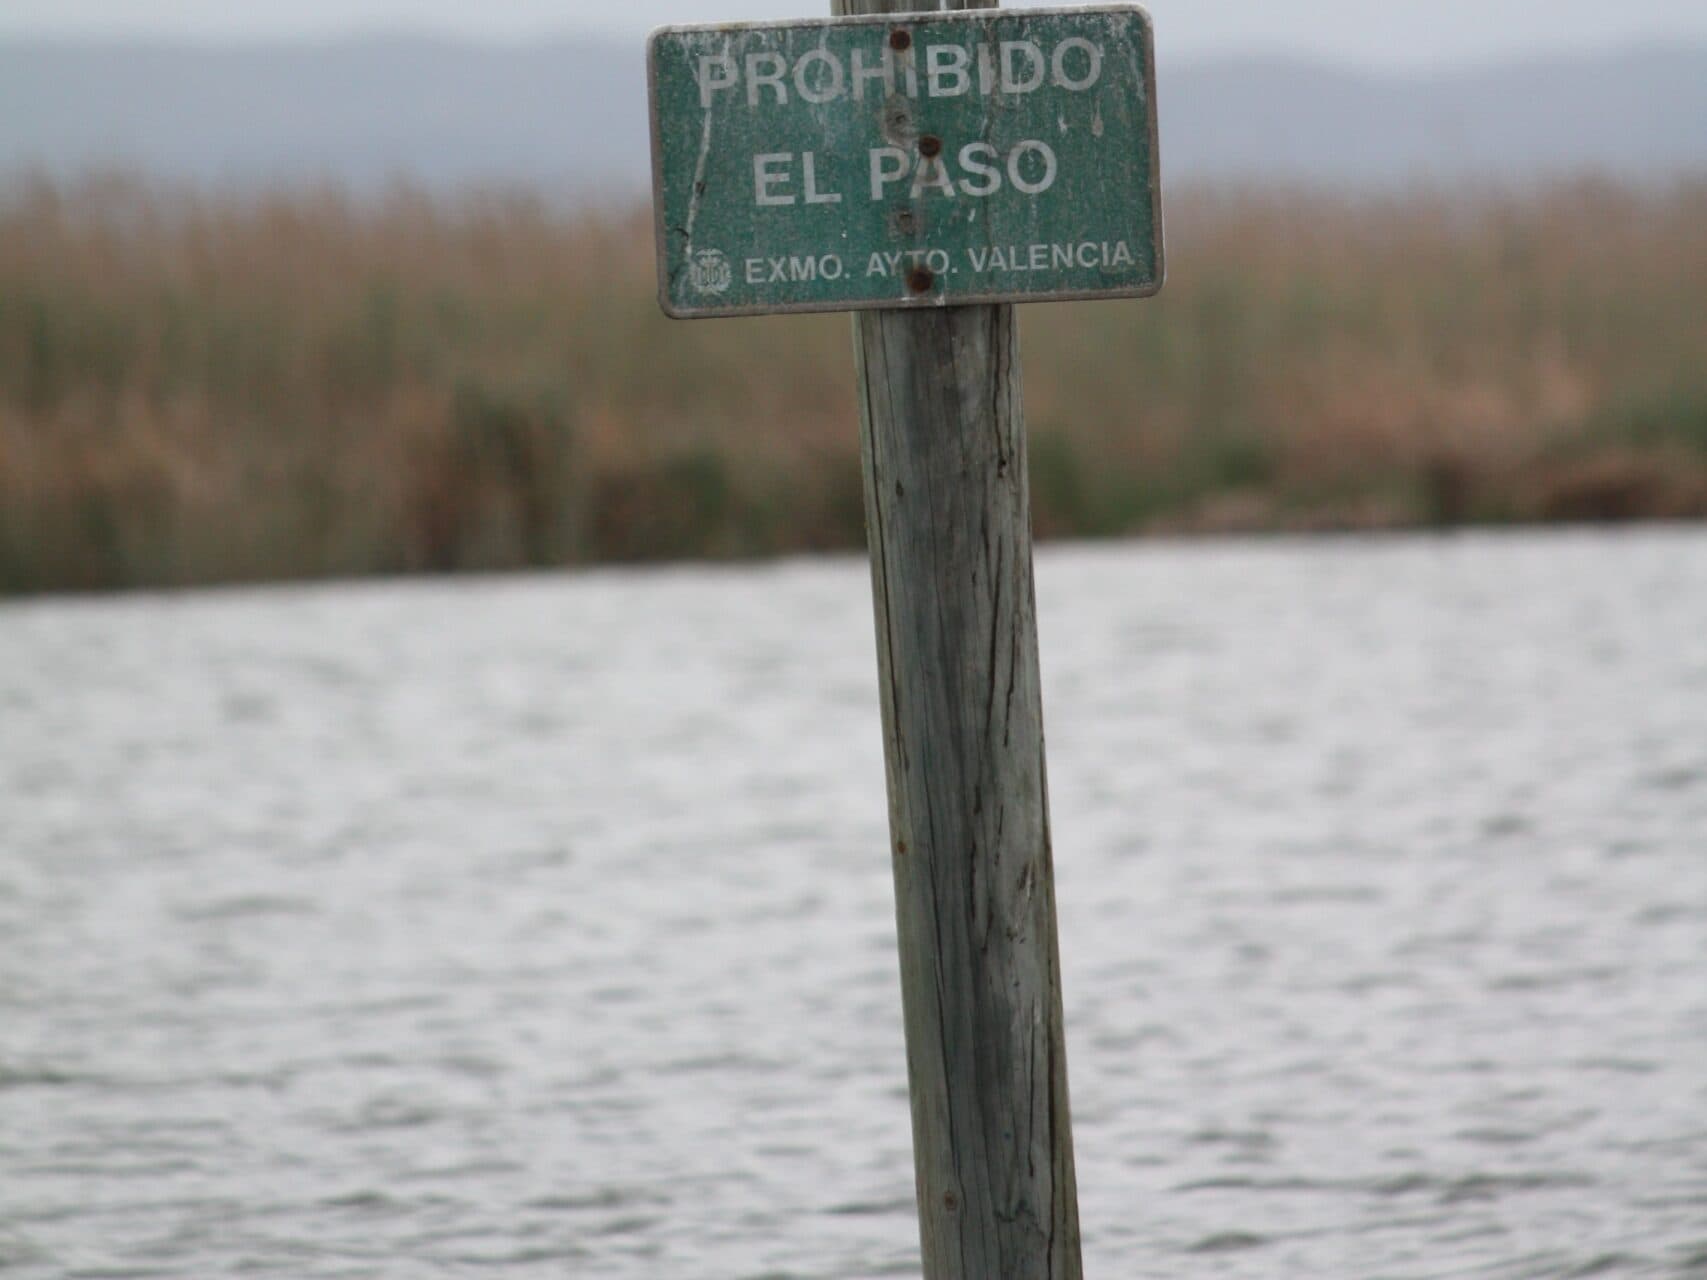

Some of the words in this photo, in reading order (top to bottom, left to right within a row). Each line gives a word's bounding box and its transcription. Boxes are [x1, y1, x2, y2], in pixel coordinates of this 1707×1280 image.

[700, 37, 1103, 107] PROHIBIDO
[753, 152, 841, 206] EL
[869, 139, 1057, 201] PASO
[745, 253, 850, 284] EXMO.
[866, 248, 958, 278] AYTO.
[968, 241, 1135, 274] VALENCIA
